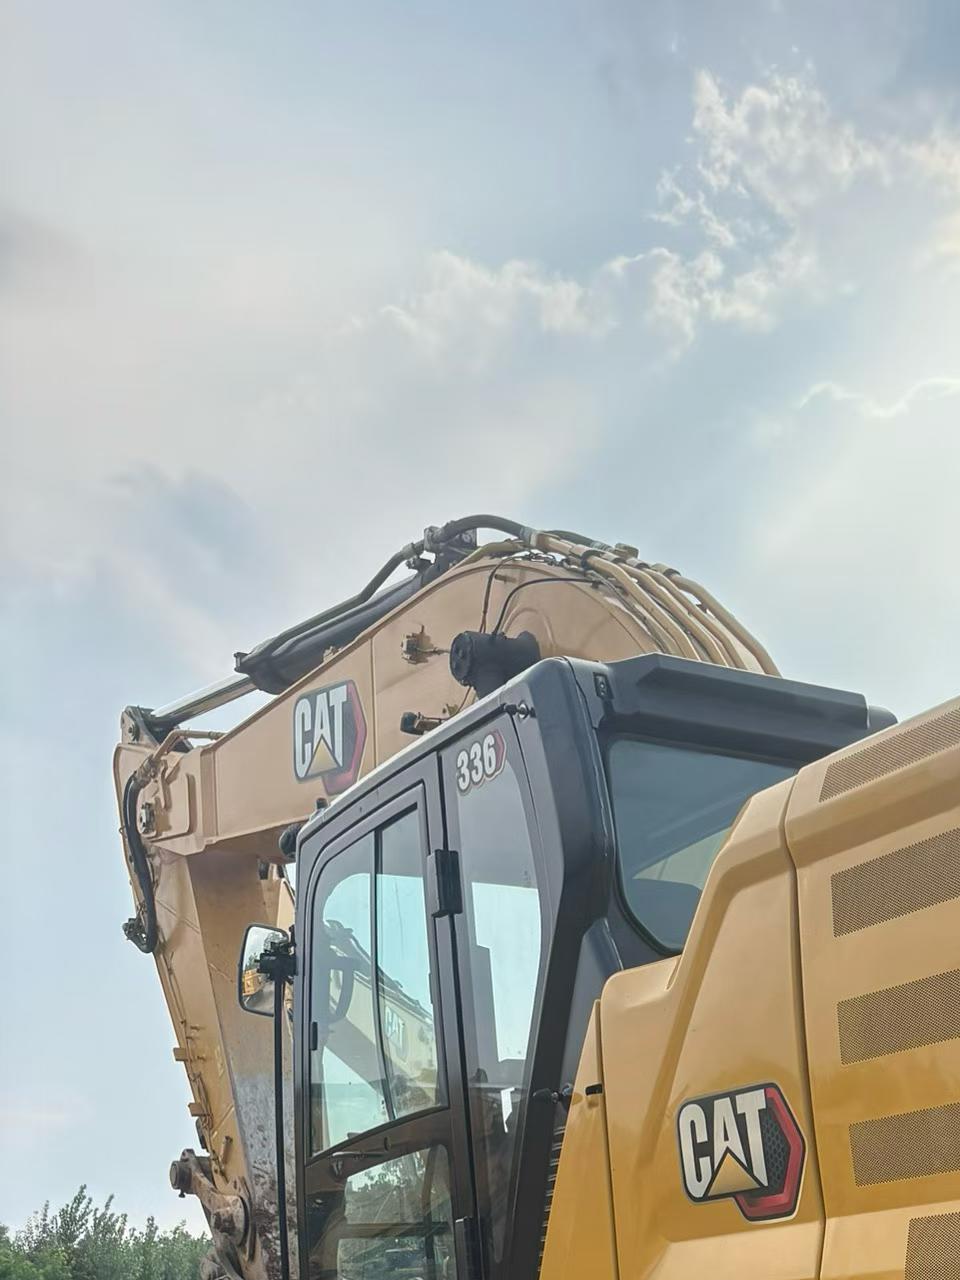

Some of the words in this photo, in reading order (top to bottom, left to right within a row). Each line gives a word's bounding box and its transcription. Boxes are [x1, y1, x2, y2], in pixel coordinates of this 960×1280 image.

[295, 685, 347, 778] CAT
[457, 734, 496, 790] 336
[679, 1088, 768, 1198] CAT
